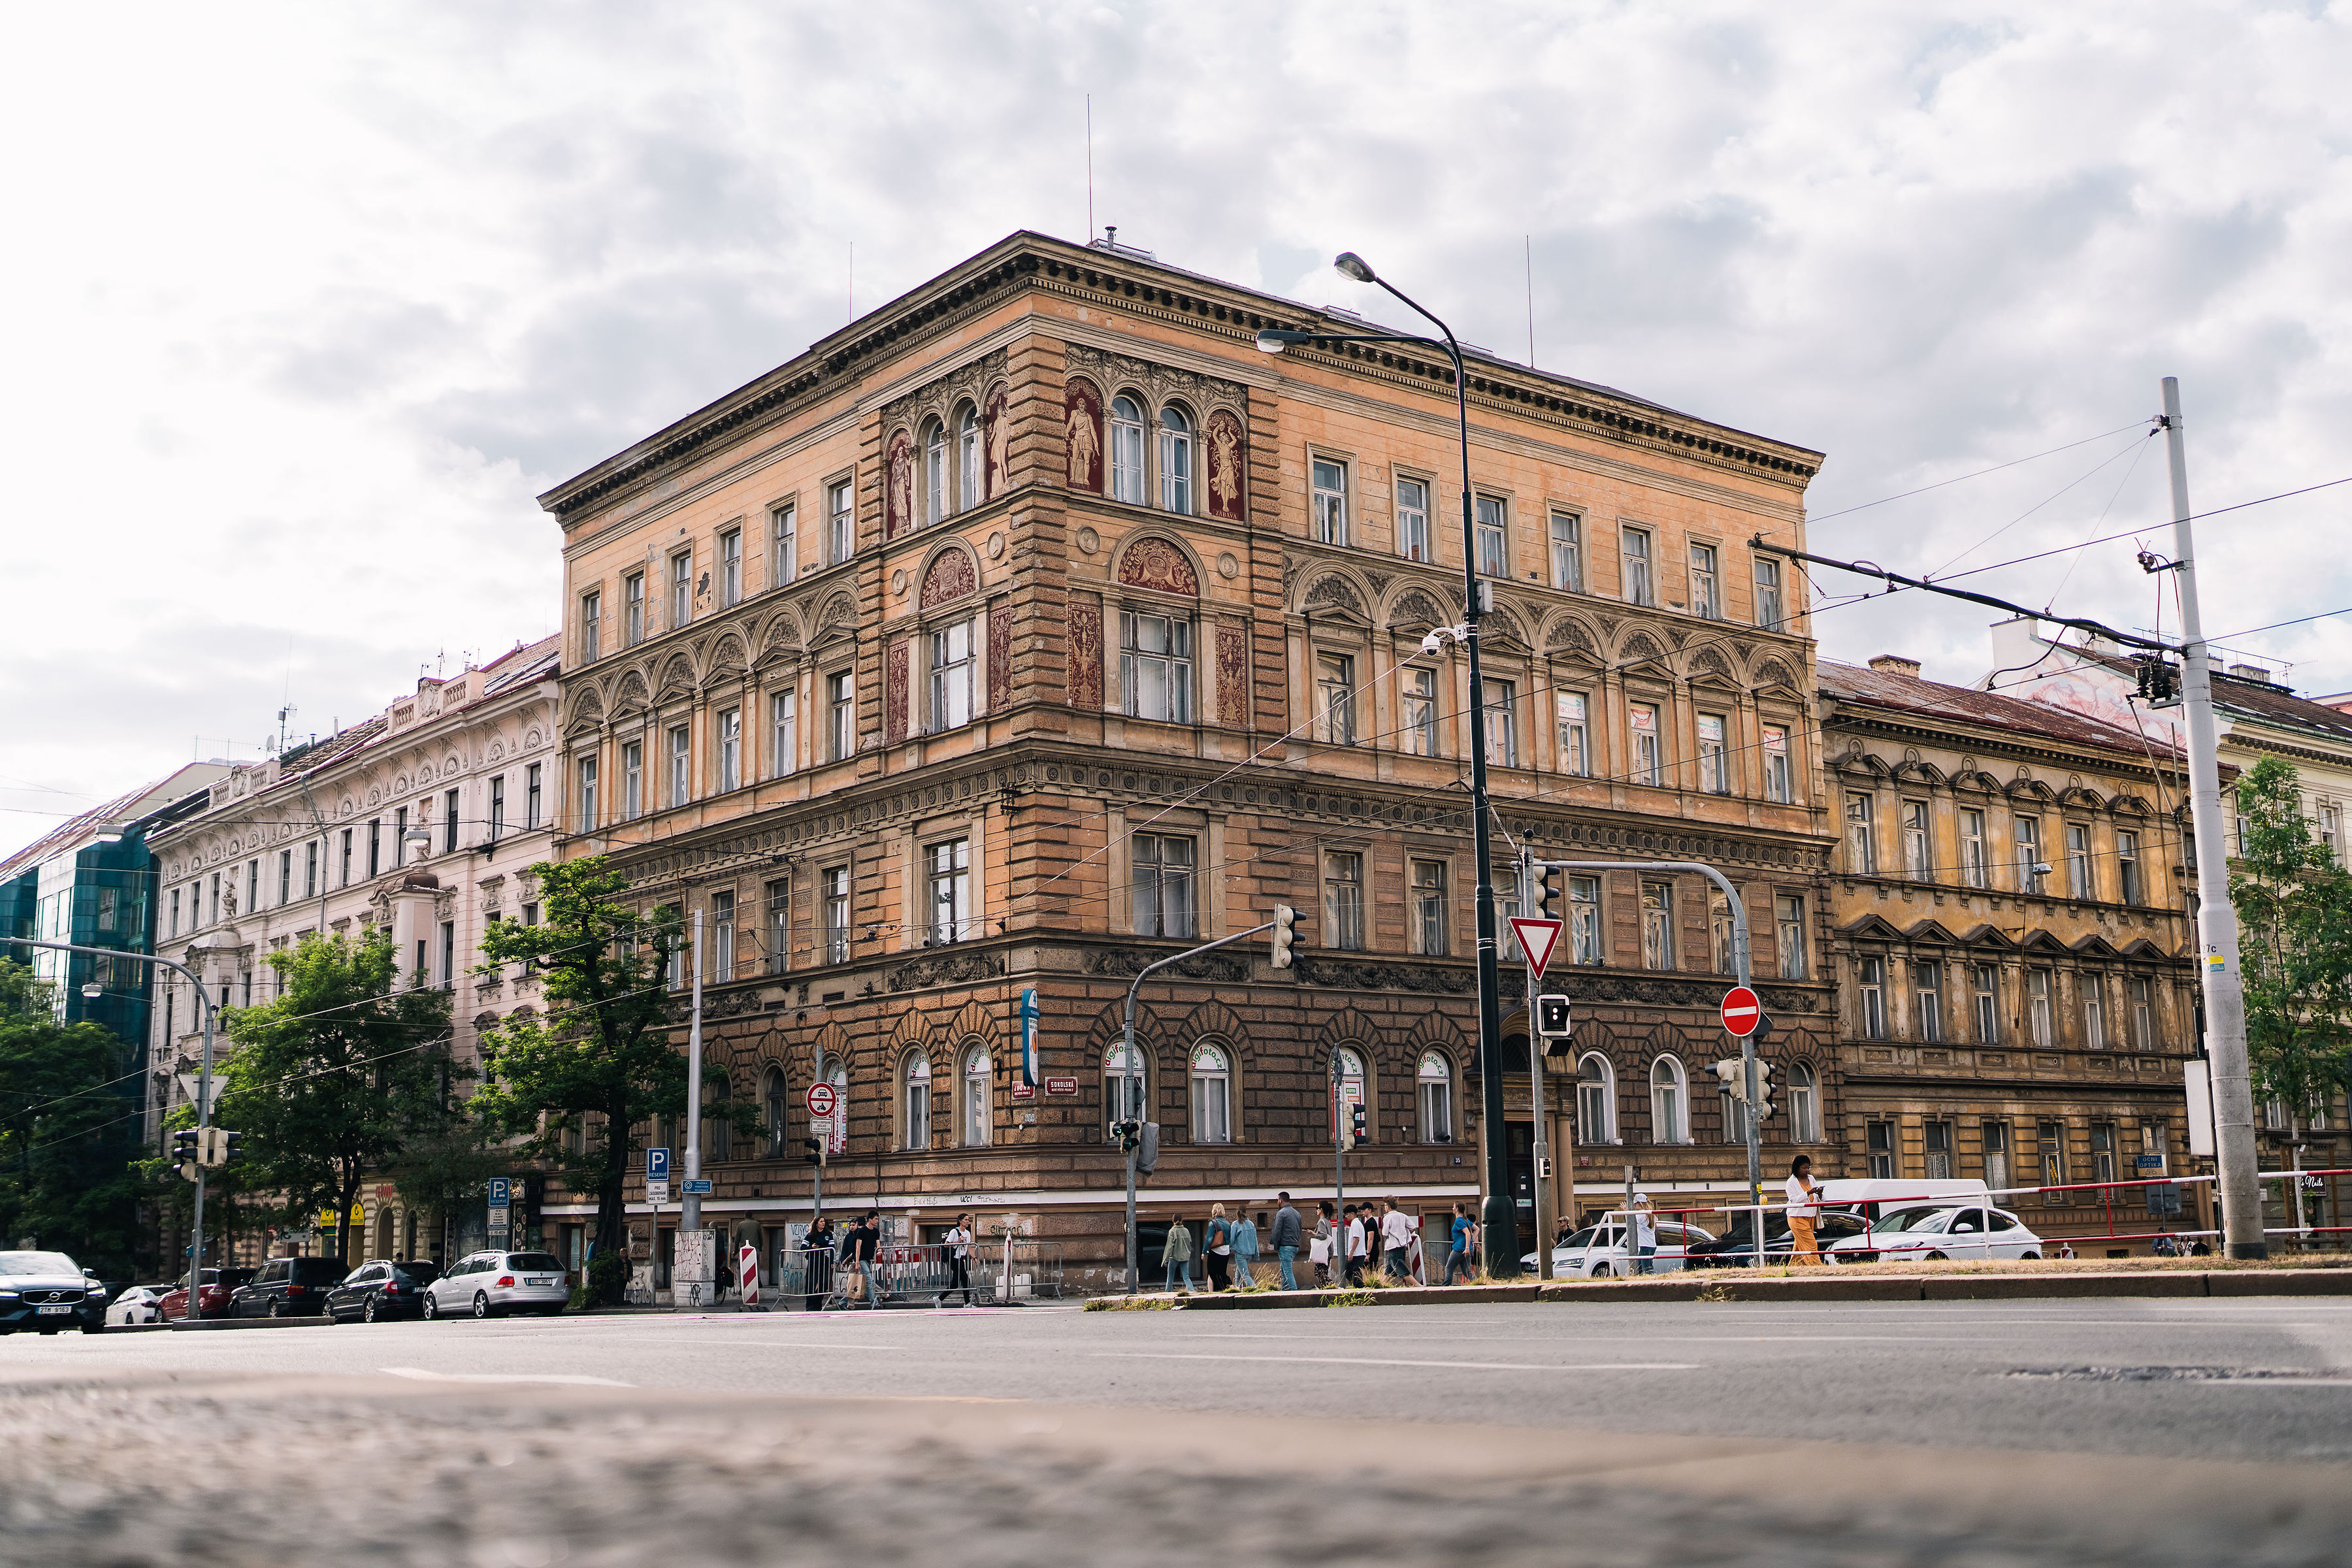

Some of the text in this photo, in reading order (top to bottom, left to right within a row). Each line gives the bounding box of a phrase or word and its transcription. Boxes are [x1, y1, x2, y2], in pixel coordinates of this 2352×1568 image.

[1192, 1047, 1222, 1069] digifoto.cz
[652, 1152, 664, 1171] P
[493, 1181, 505, 1198] P
[2305, 1175, 2324, 1188] Nails
